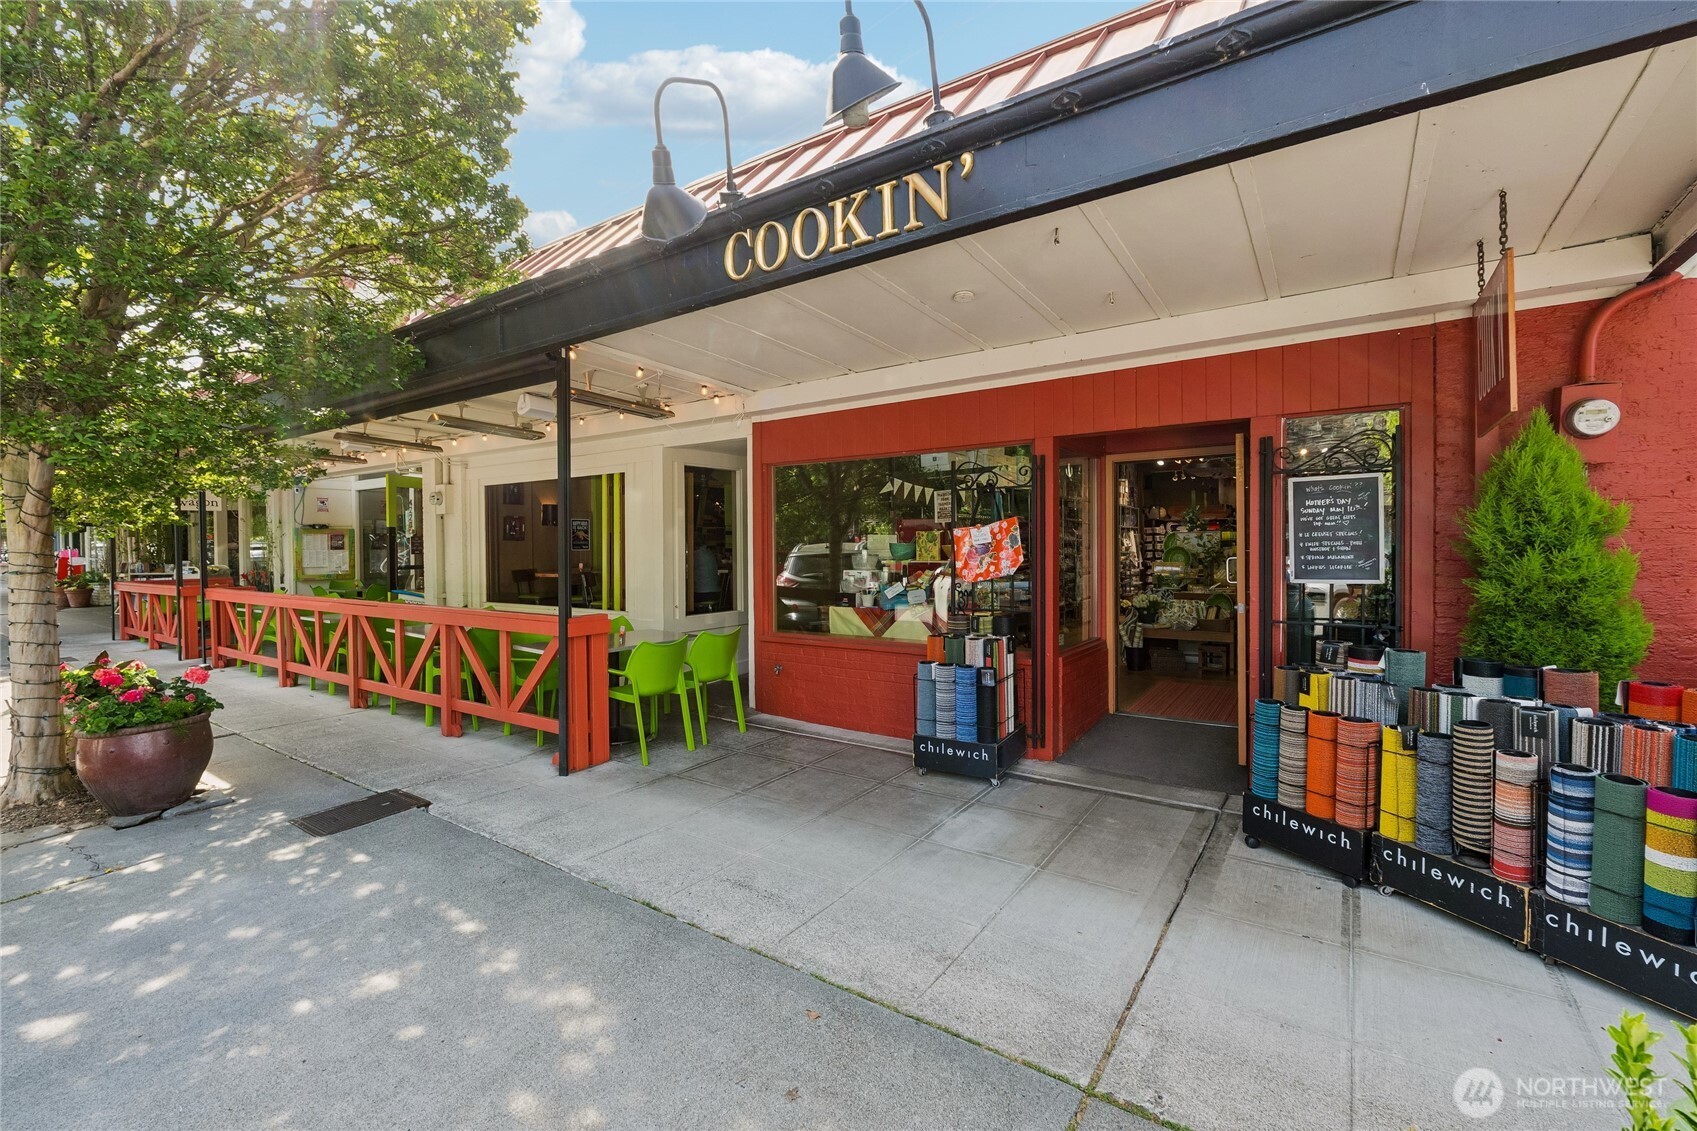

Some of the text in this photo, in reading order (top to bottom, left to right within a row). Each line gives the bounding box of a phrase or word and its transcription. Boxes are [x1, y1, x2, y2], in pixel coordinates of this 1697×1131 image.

[724, 150, 974, 281] COOKIN'
[1300, 507, 1325, 515] SUNDAY
[919, 741, 989, 761] chilewich
[1252, 804, 1352, 850] chilewich
[1383, 849, 1512, 908] chilewich
